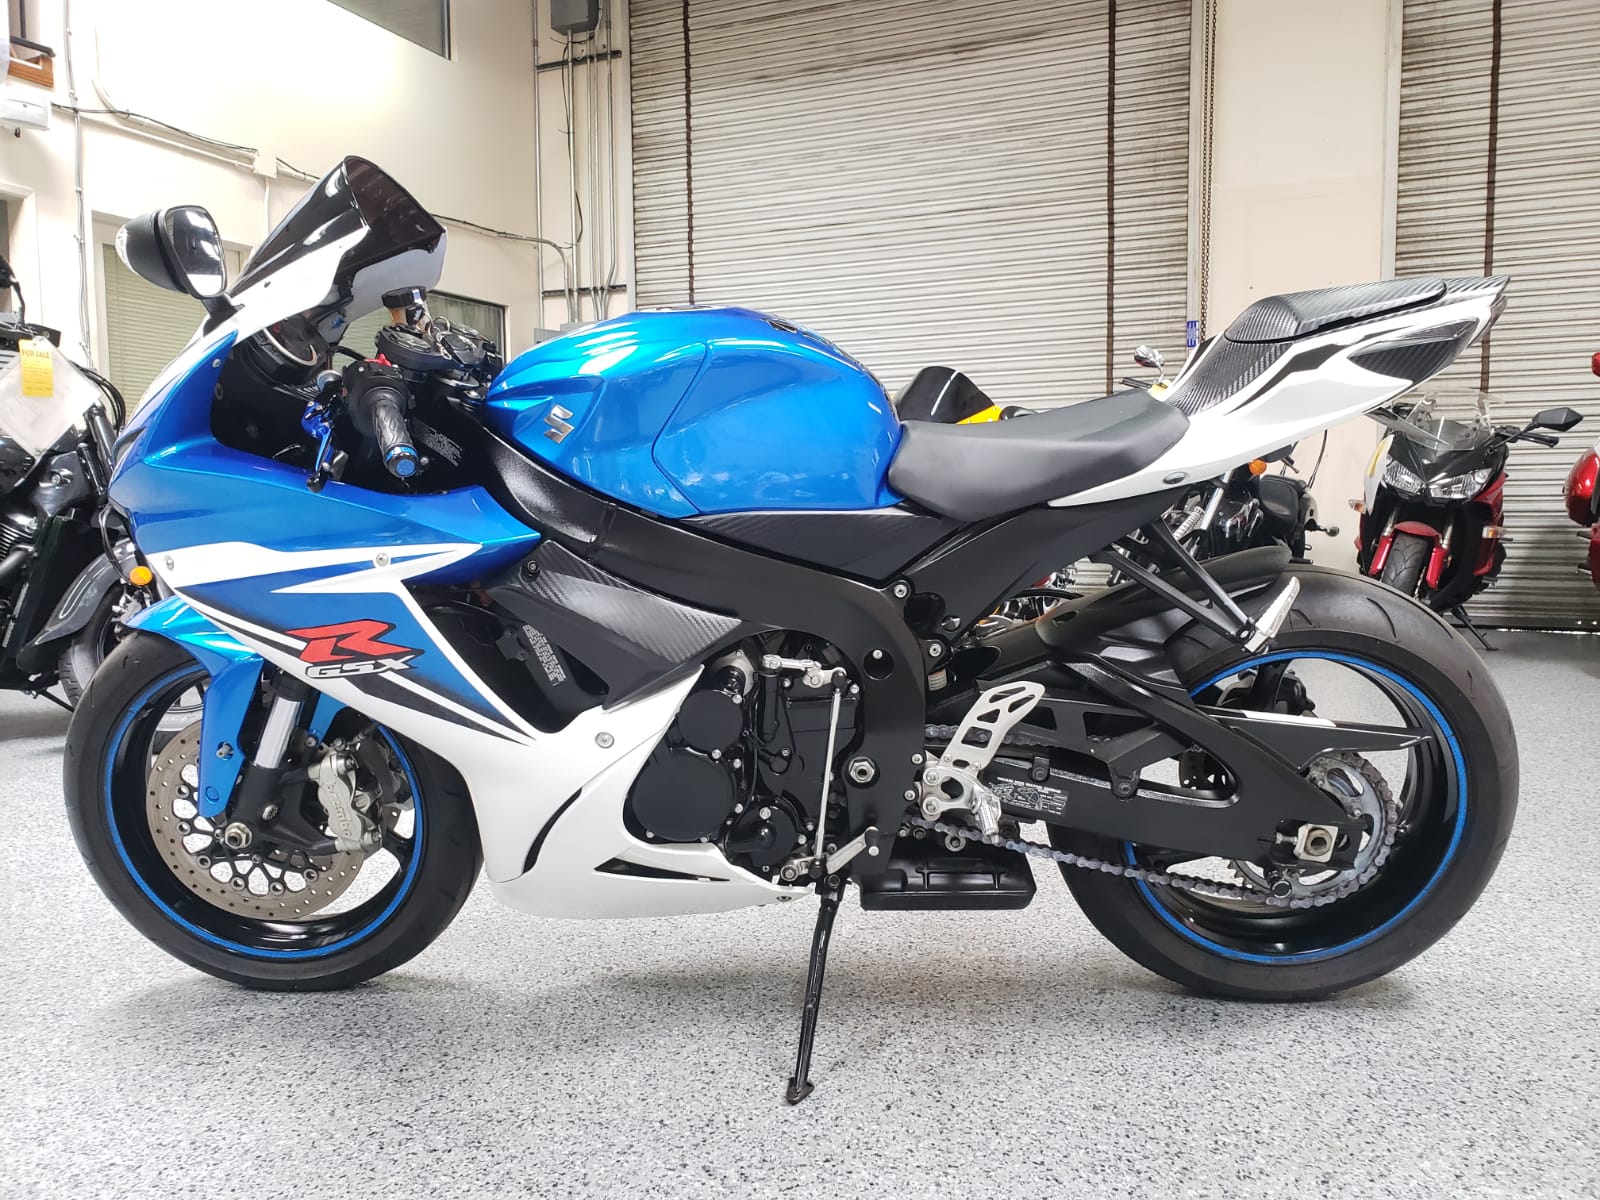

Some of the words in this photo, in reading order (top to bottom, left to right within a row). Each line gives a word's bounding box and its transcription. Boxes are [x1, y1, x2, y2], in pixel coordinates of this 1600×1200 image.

[21, 348, 34, 358] FOR
[306, 654, 417, 678] GSX
[326, 781, 352, 838] brembo
